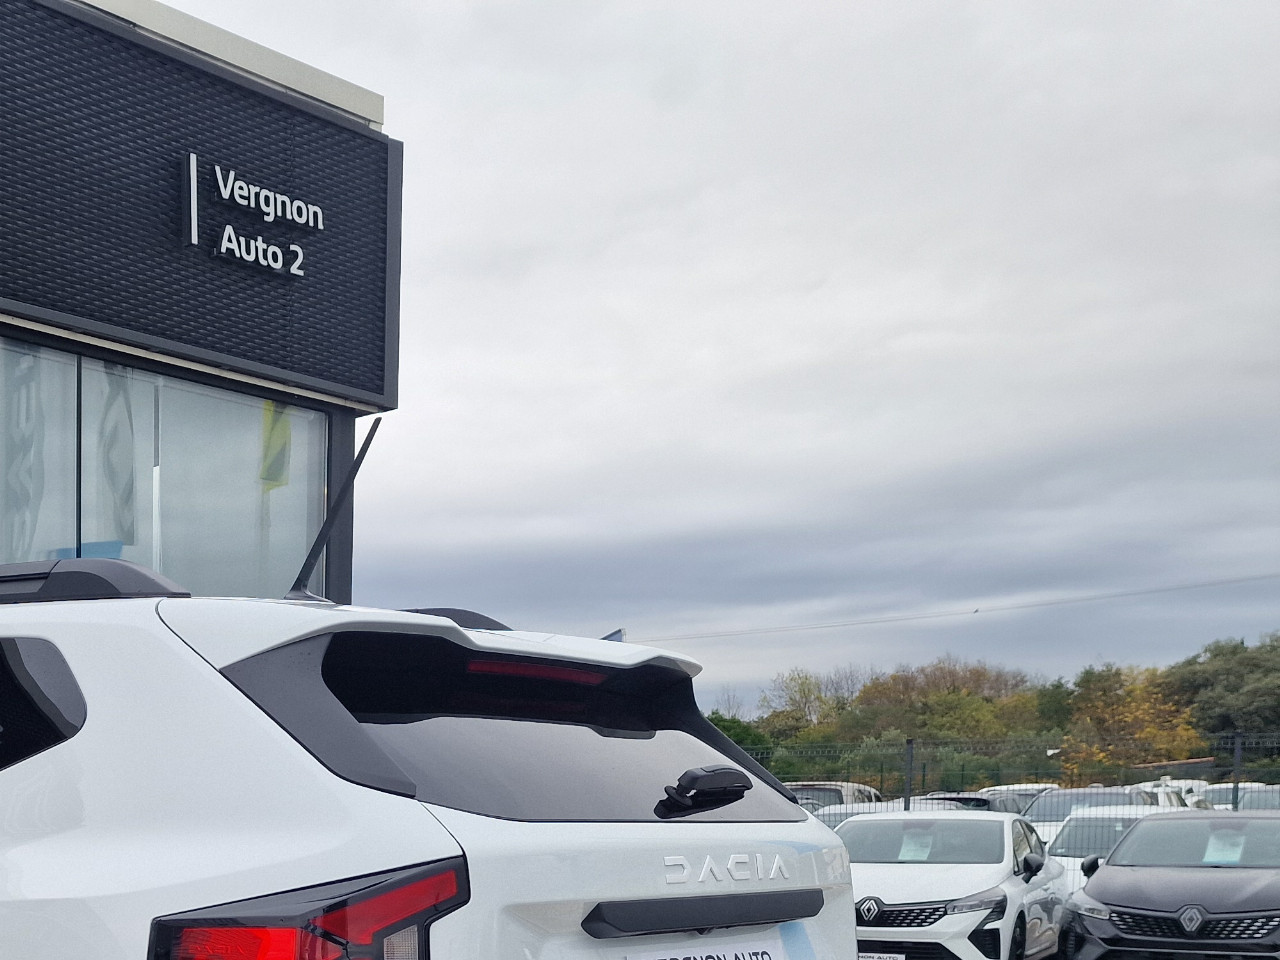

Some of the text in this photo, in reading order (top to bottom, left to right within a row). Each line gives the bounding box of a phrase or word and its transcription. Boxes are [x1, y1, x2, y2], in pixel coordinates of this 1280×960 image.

[215, 165, 324, 230] Vergnon
[221, 225, 305, 276] Auto 2
[663, 853, 790, 885] DACIA
